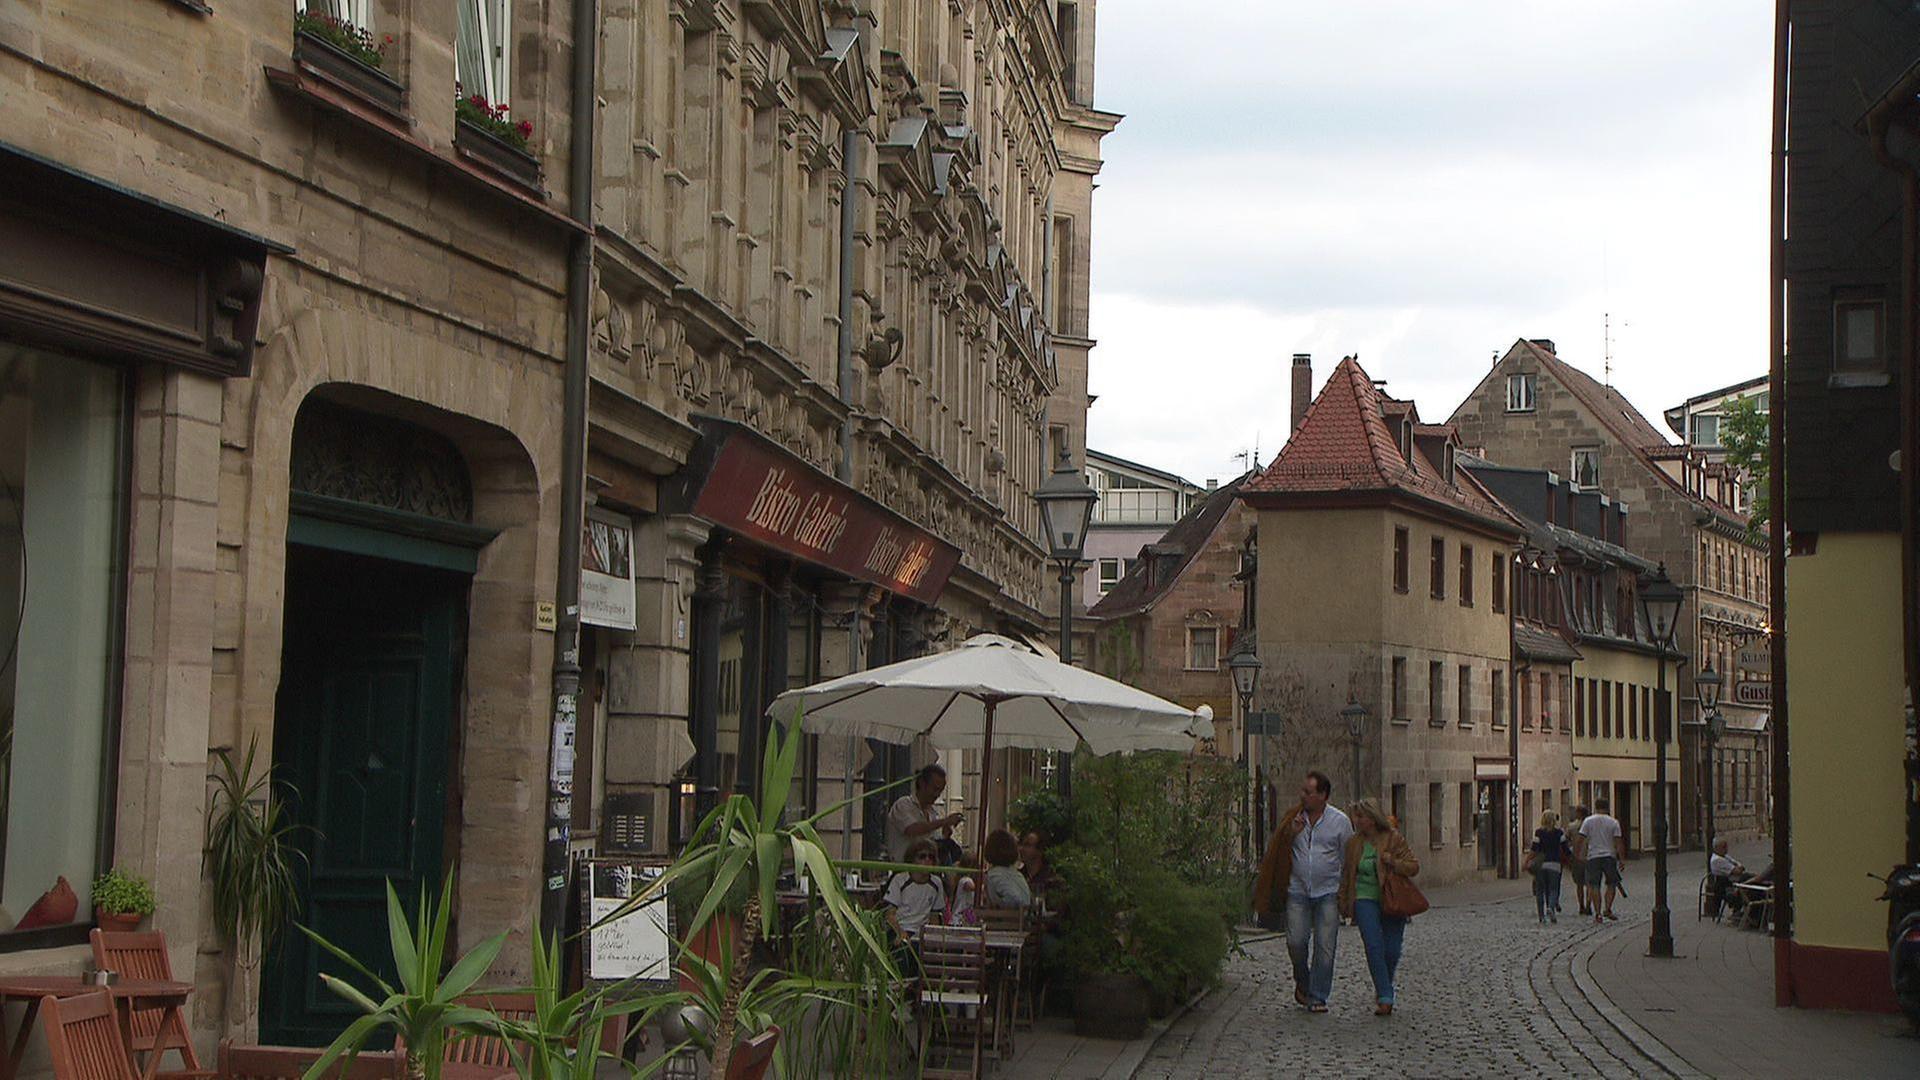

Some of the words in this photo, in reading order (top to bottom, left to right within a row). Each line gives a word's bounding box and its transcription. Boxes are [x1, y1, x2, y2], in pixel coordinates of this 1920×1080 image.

[745, 467, 800, 535] Bistro
[794, 491, 849, 553] Galerie
[863, 526, 903, 575] Bistro
[893, 538, 934, 588] Galerie
[1741, 652, 1770, 663] KULM
